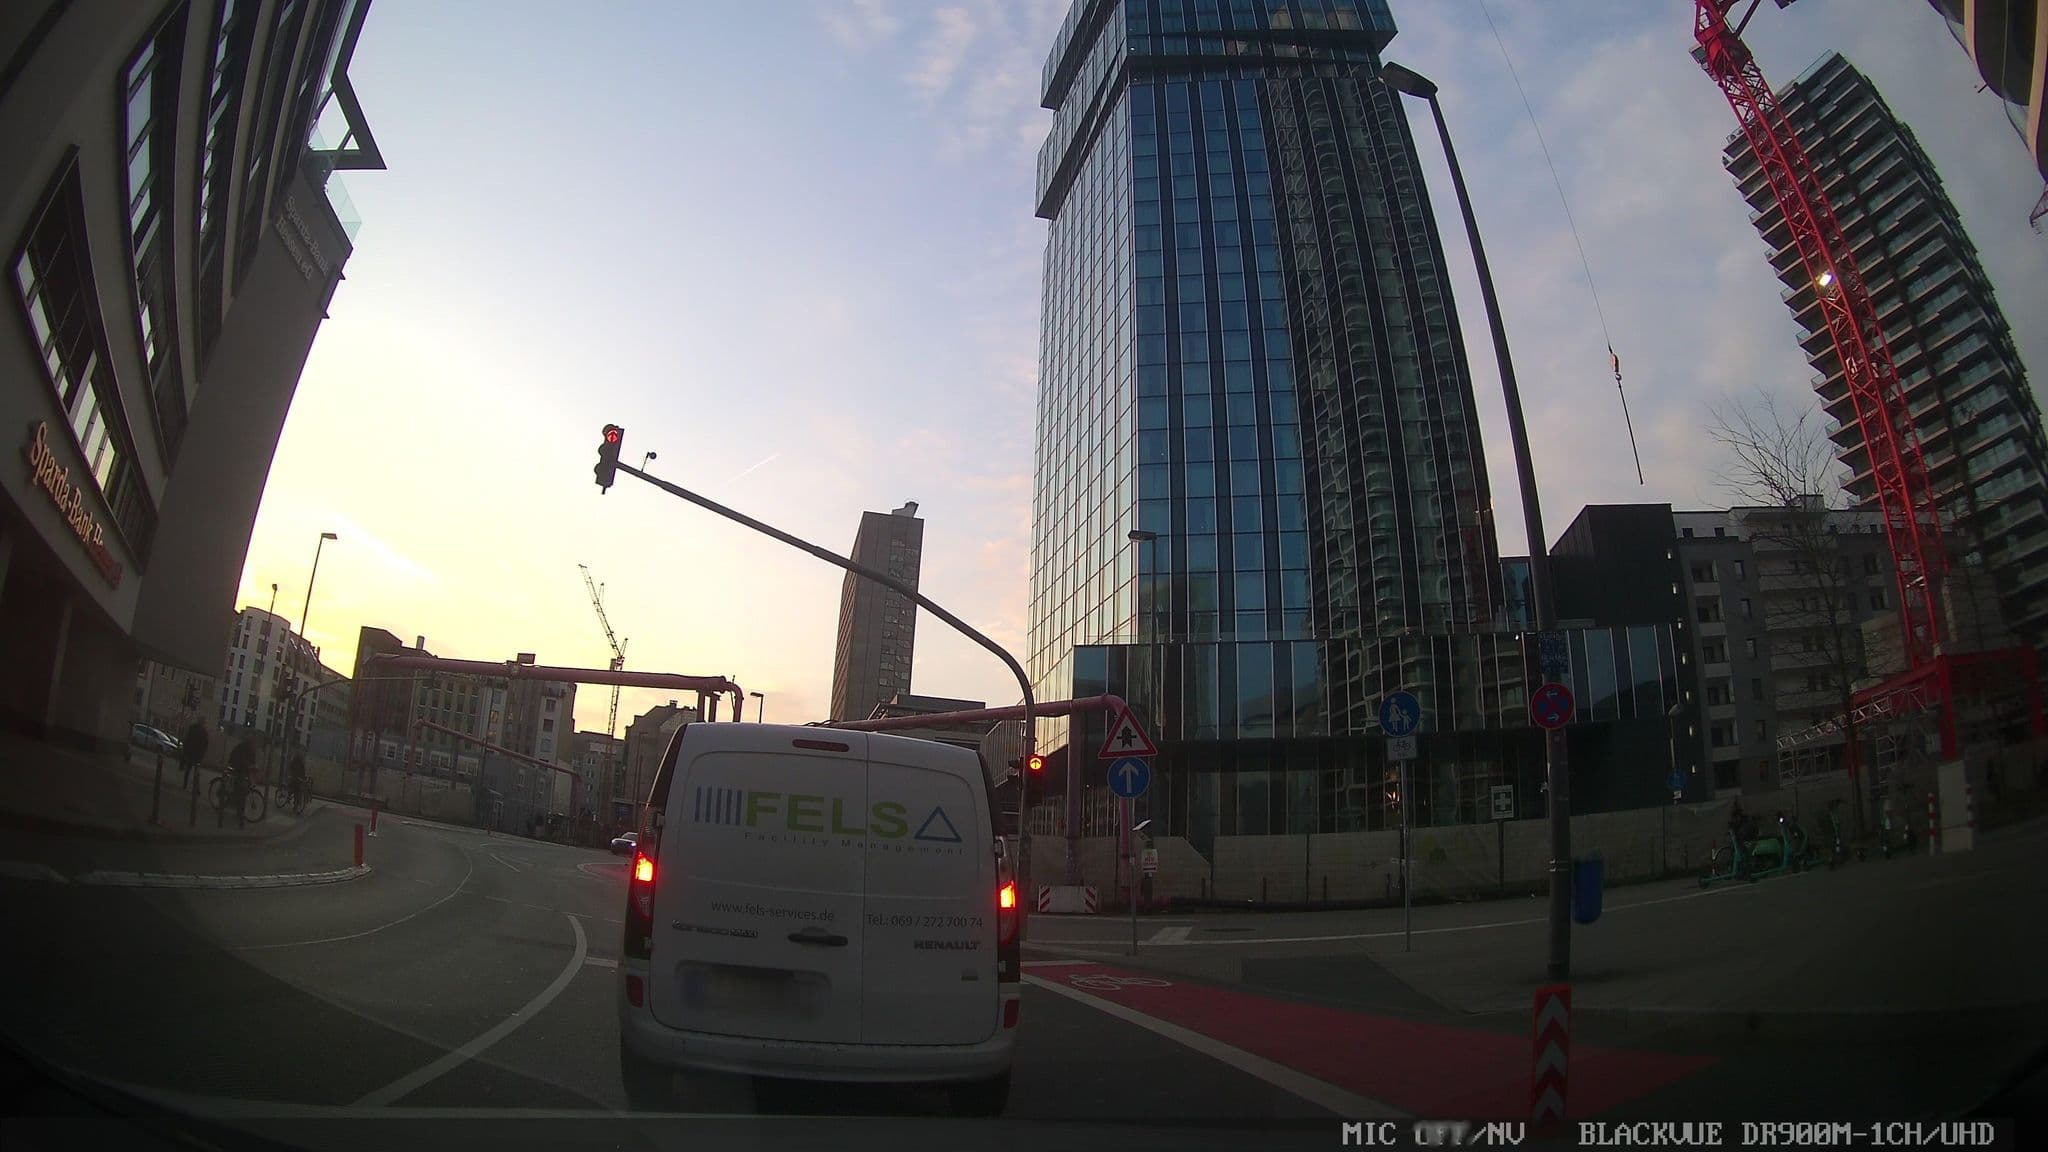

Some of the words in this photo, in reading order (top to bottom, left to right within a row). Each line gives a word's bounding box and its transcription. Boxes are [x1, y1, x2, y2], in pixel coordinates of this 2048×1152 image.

[30, 420, 94, 543] Sparda-Bank
[745, 791, 908, 838] FELS
[744, 831, 829, 847] Facility
[841, 839, 966, 855] Management
[711, 901, 834, 921] www.fels-services.de
[868, 914, 888, 926] Tel.:
[891, 915, 912, 927] 069
[923, 916, 943, 928] 272
[947, 916, 967, 928] 700
[970, 917, 983, 928] 74
[913, 940, 982, 950] RENAULT
